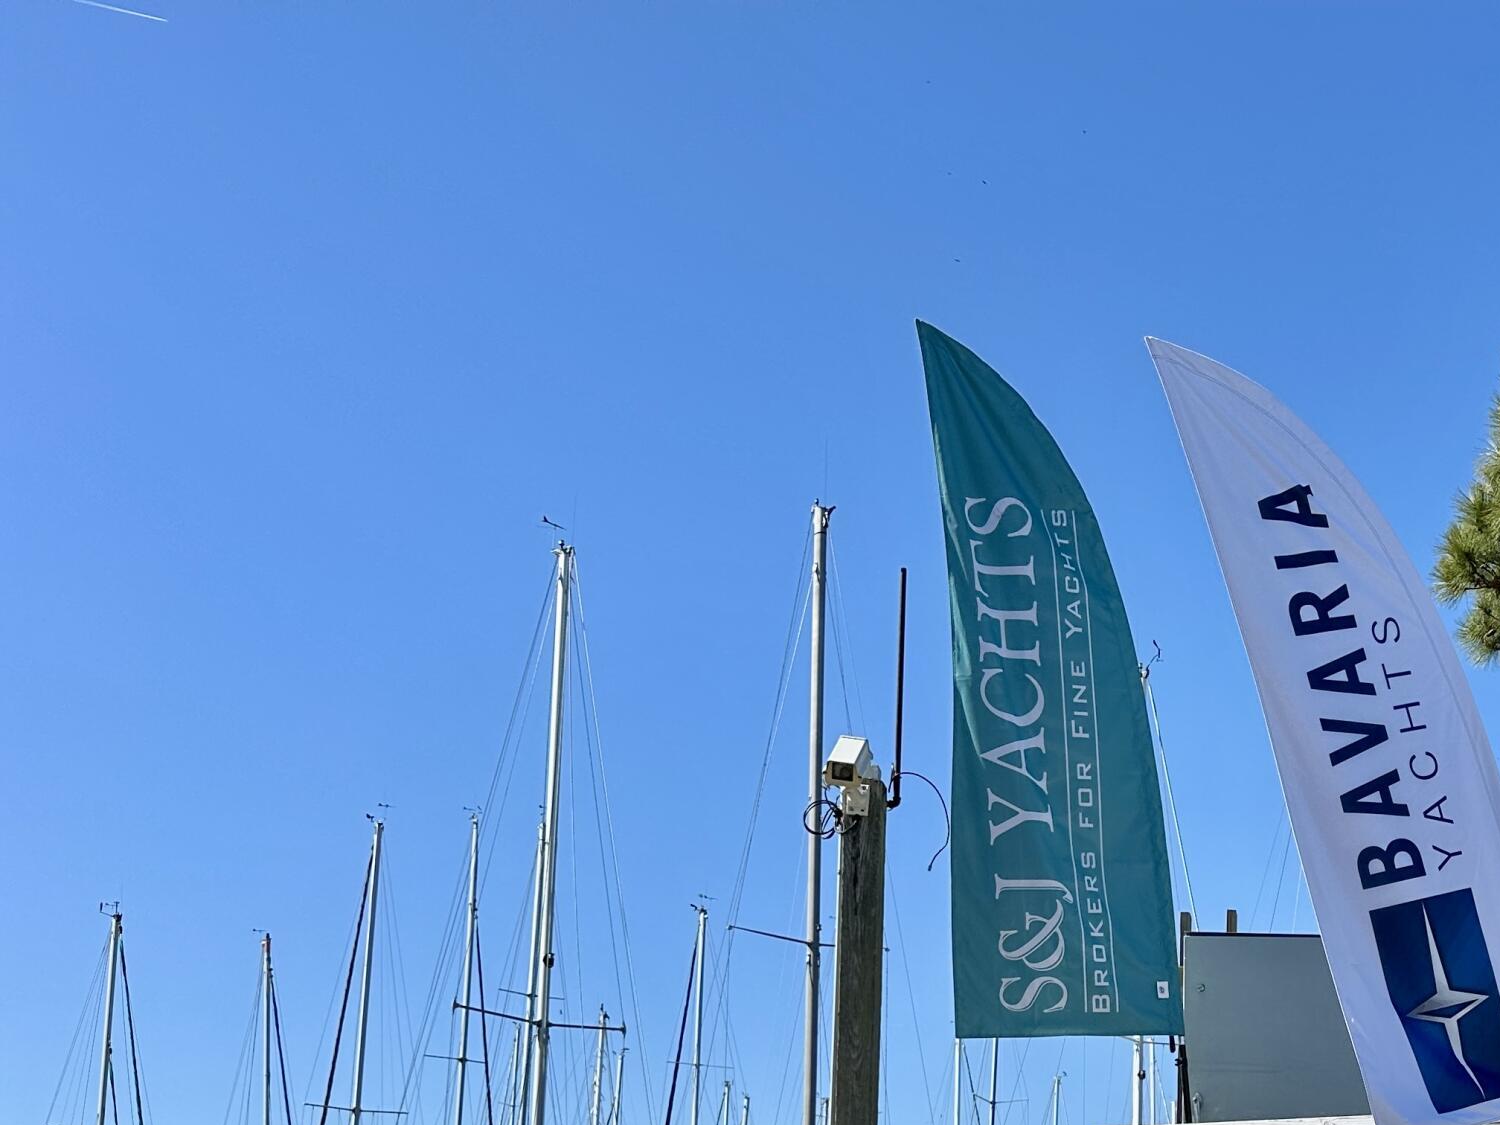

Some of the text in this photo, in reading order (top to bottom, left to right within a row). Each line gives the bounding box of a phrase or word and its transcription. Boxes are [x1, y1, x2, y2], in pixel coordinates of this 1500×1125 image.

[964, 494, 1076, 1014] S&J YACHTS
[1050, 506, 1112, 1014] BROKERS FOR FINE YACHTS
[1257, 483, 1427, 890] BAVARIA
[1372, 615, 1467, 871] YACHTS
